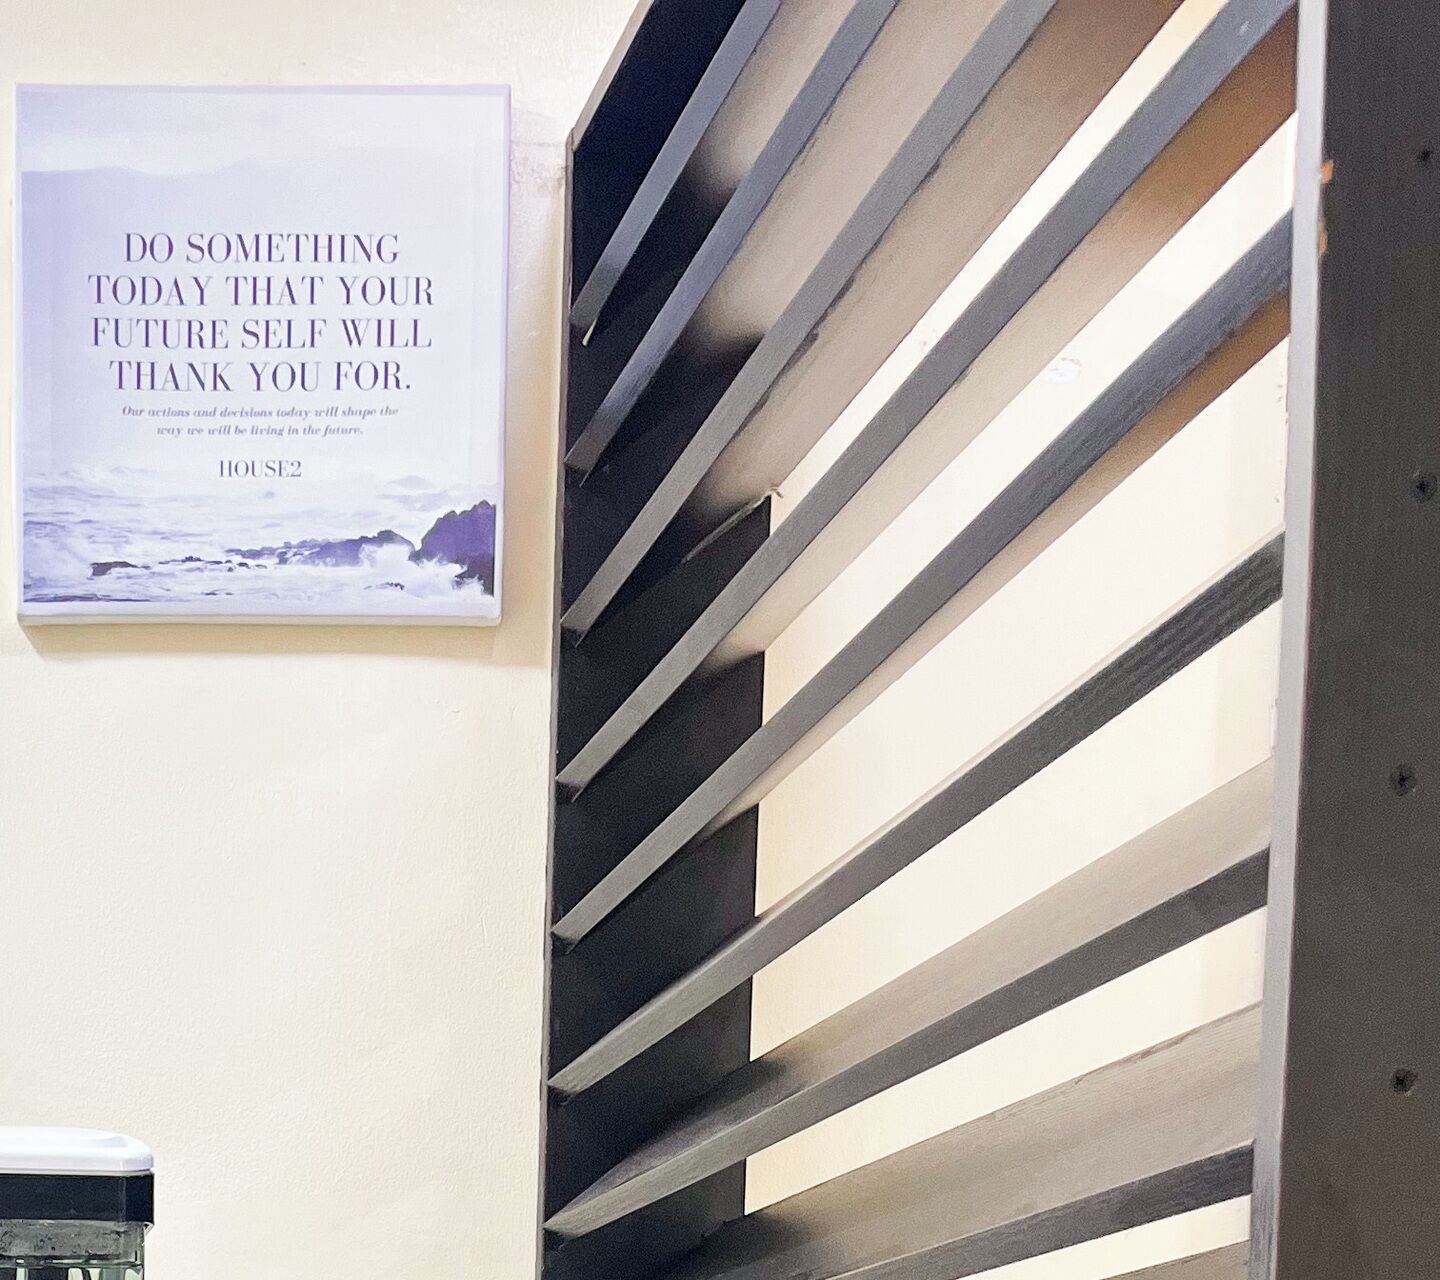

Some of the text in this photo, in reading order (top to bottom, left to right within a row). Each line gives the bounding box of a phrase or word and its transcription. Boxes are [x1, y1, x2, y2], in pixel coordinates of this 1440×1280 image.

[124, 232, 401, 265] DO SOMETHING
[88, 274, 435, 307] TODAY THAT YOUR
[91, 317, 432, 350] FUTURE SELF WILL
[109, 360, 411, 392] THANK YOU FOR.
[122, 404, 399, 421] Our actions and decisions today will shape the
[156, 424, 364, 439] way we will be living in the future.
[219, 459, 303, 478] HOUSE2
